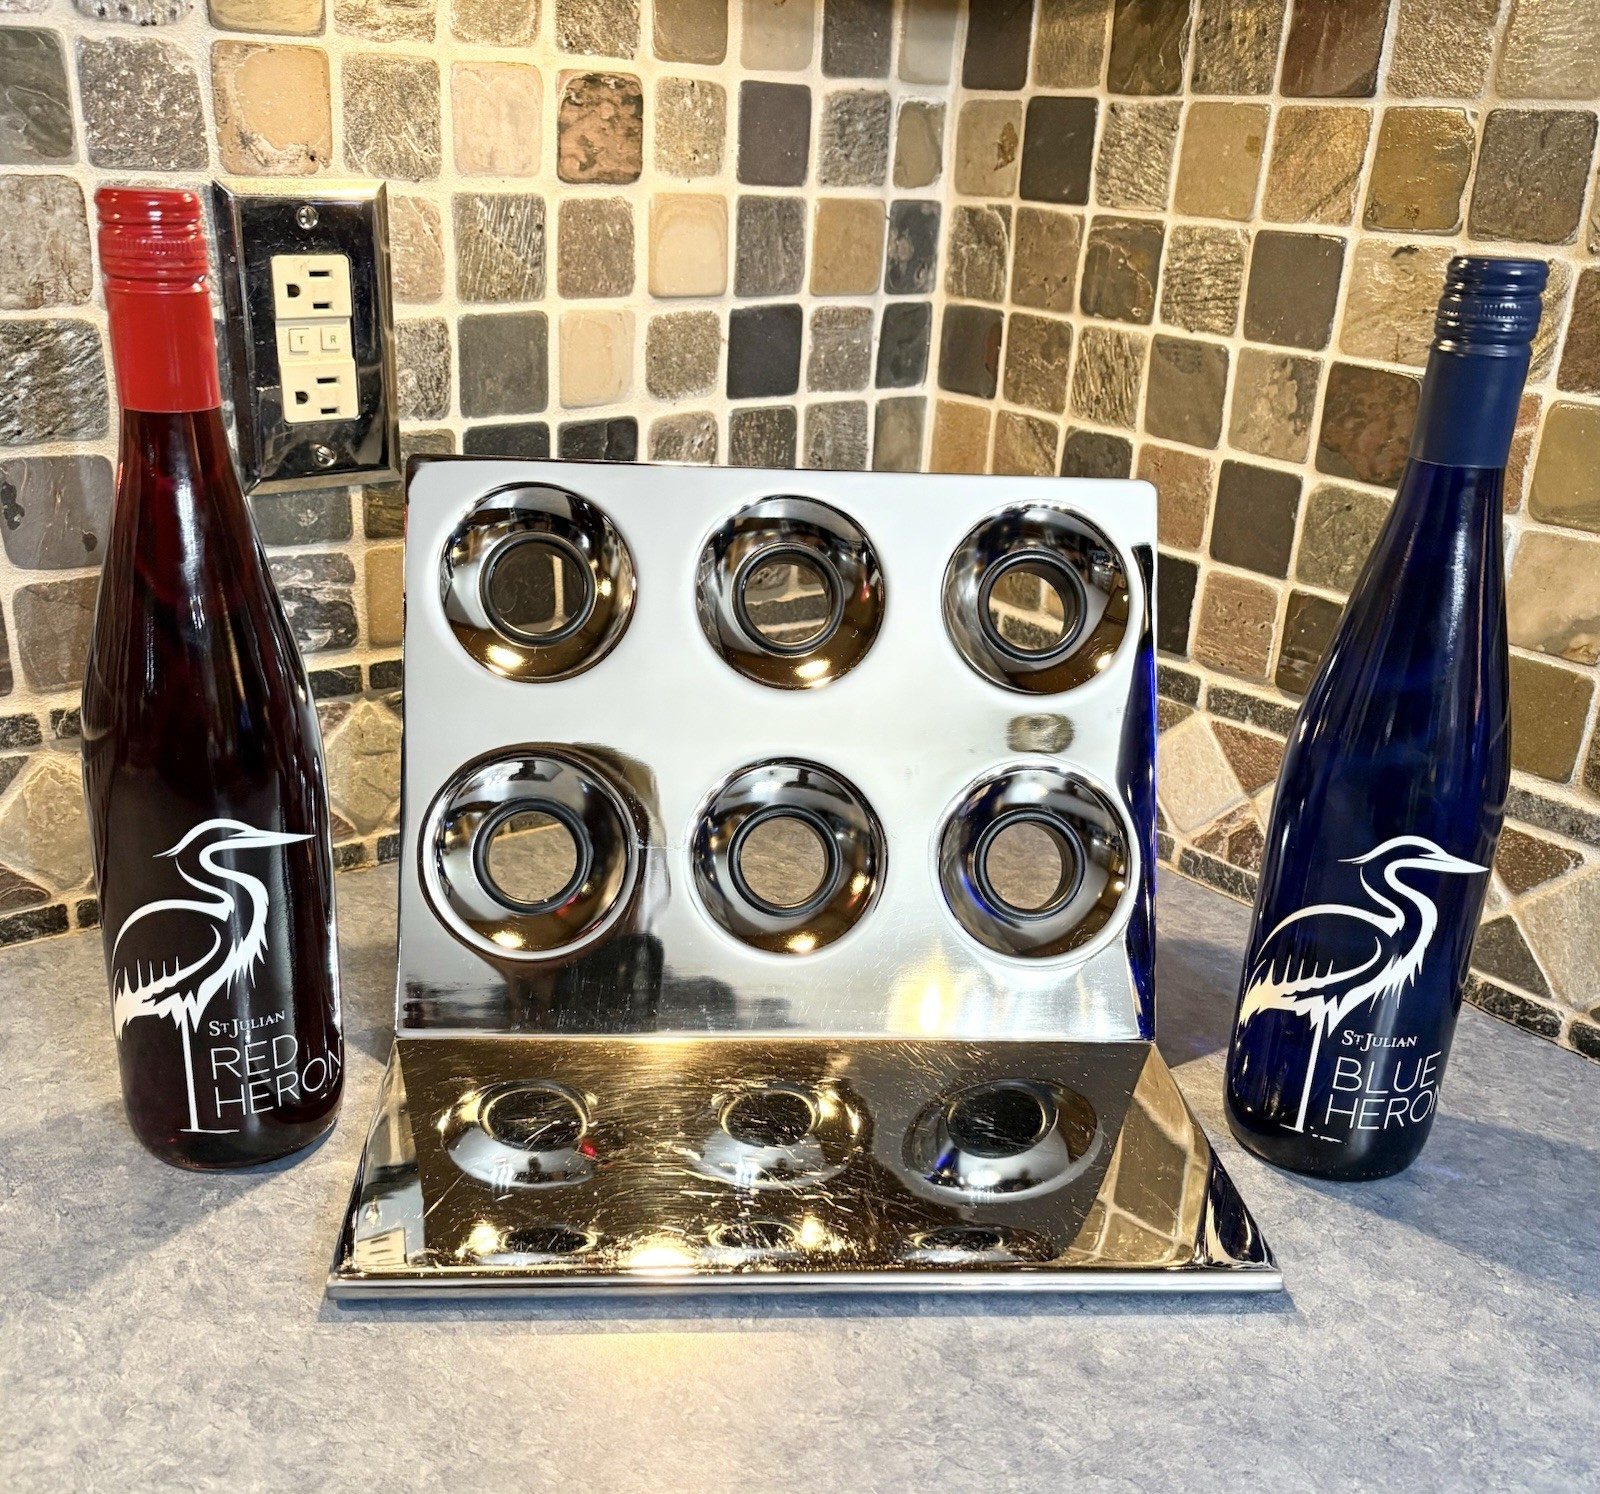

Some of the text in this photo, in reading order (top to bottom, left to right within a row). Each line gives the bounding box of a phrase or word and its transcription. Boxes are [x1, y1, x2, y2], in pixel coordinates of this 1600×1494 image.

[330, 334, 337, 344] R
[210, 1034, 299, 1081] RED
[214, 1036, 342, 1119] HERON
[1332, 1050, 1441, 1093] BLUE
